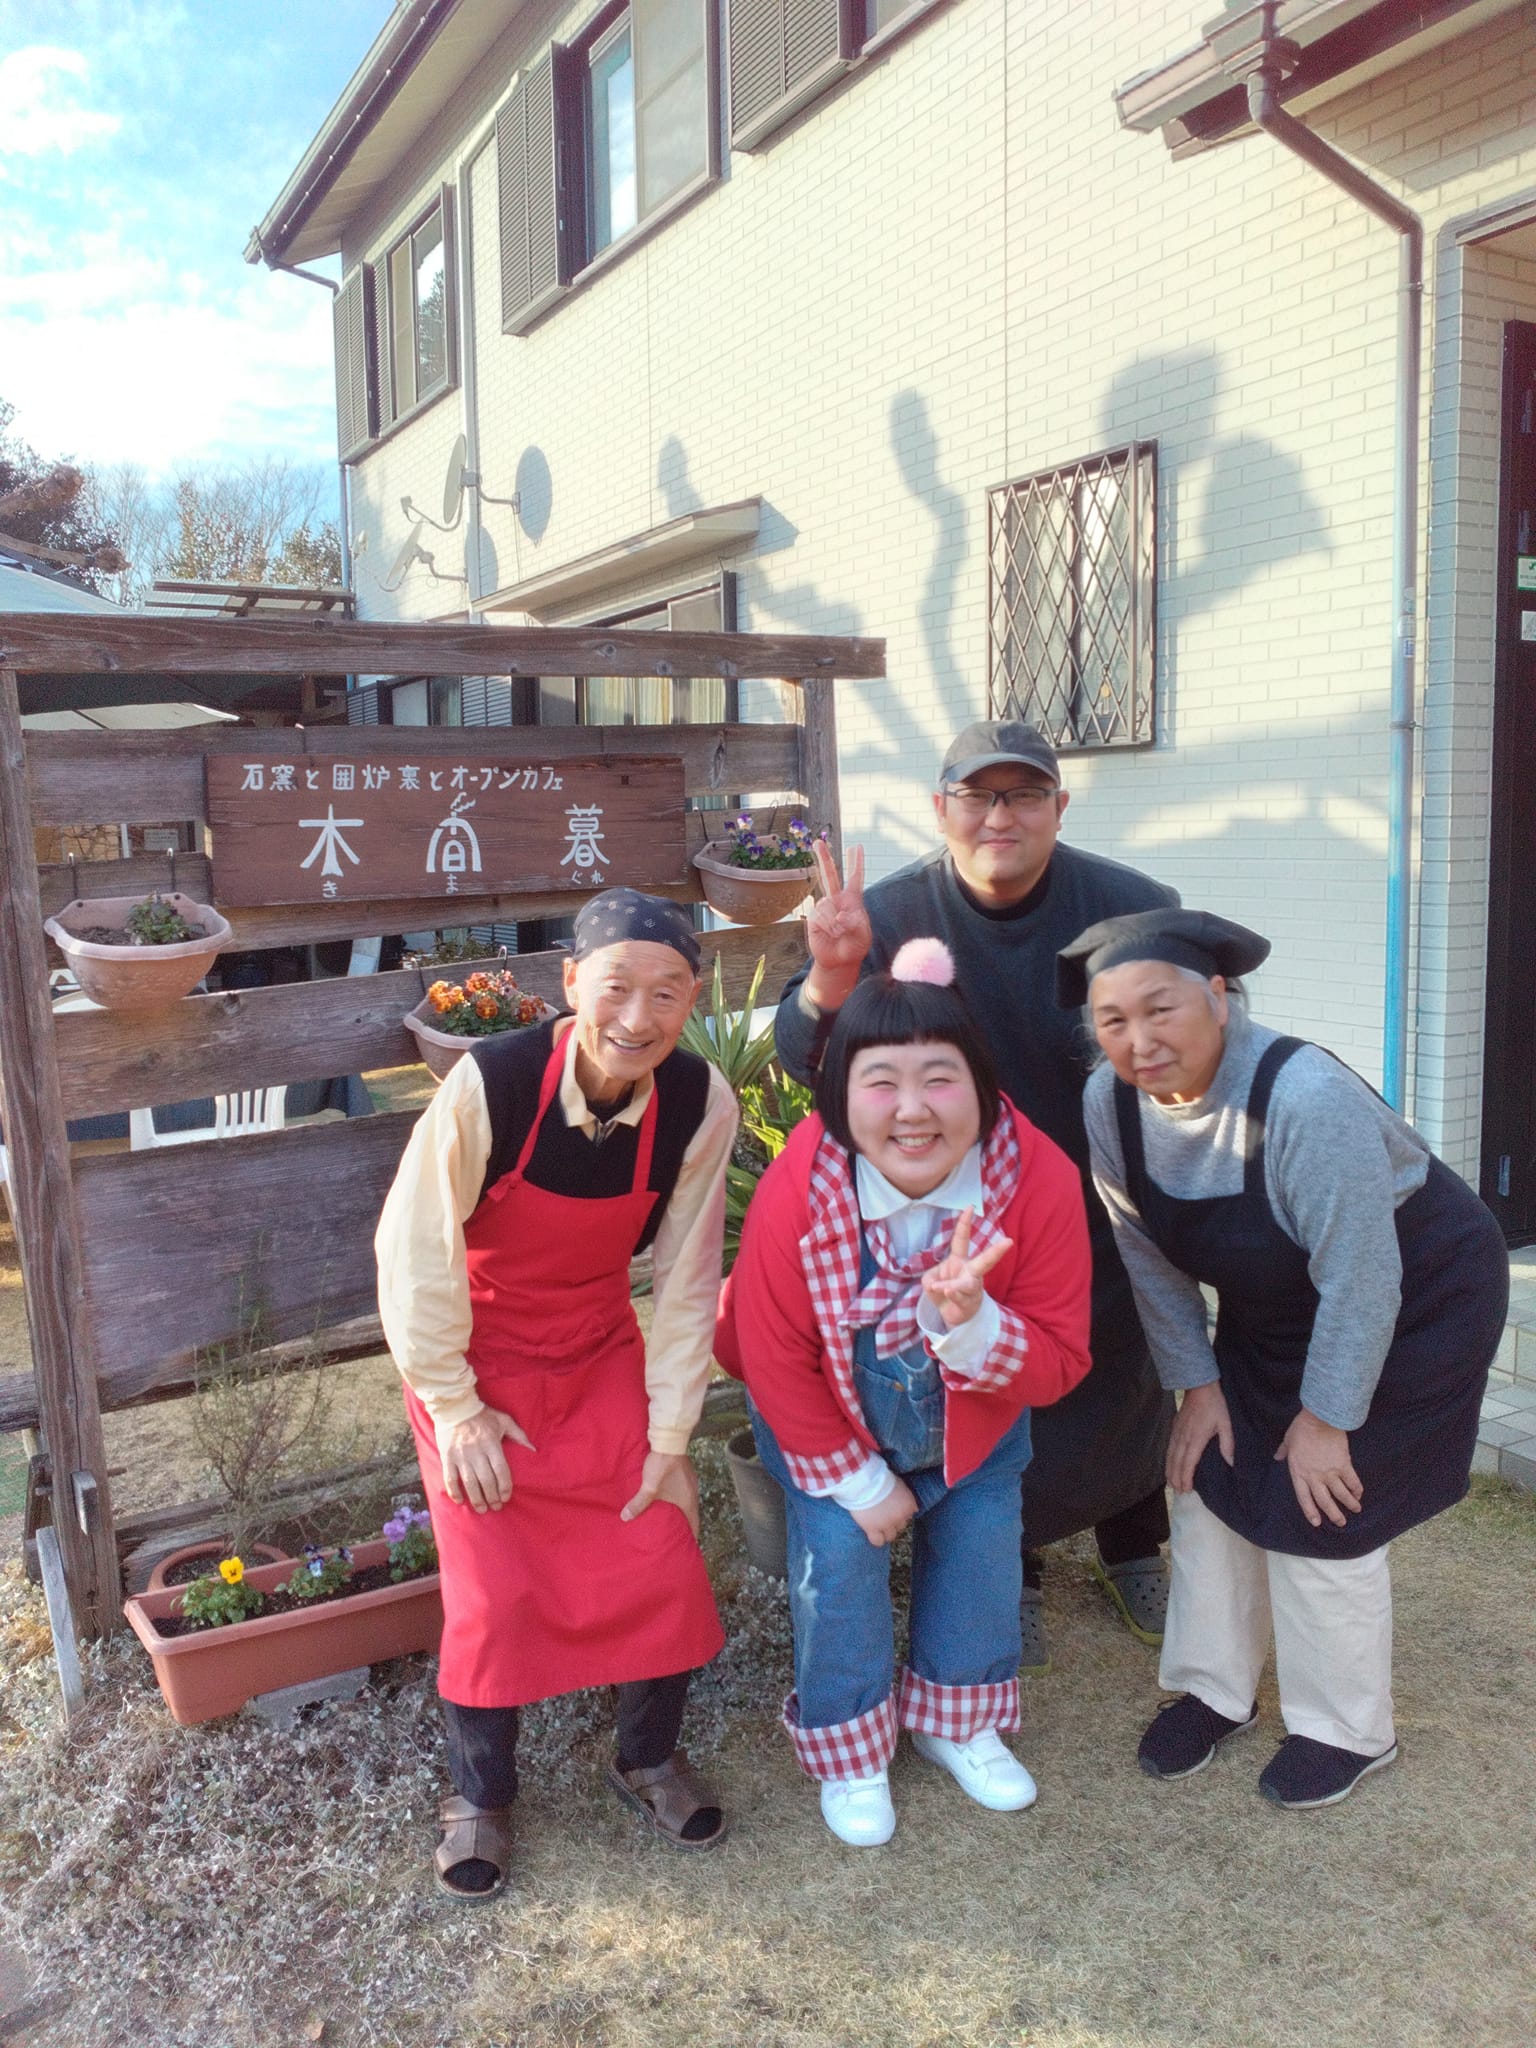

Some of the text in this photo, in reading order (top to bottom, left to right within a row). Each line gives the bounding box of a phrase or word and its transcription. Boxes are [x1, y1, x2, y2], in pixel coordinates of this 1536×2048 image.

[240, 763, 563, 792] 石窯と囲炉裏とオープンカフェ
